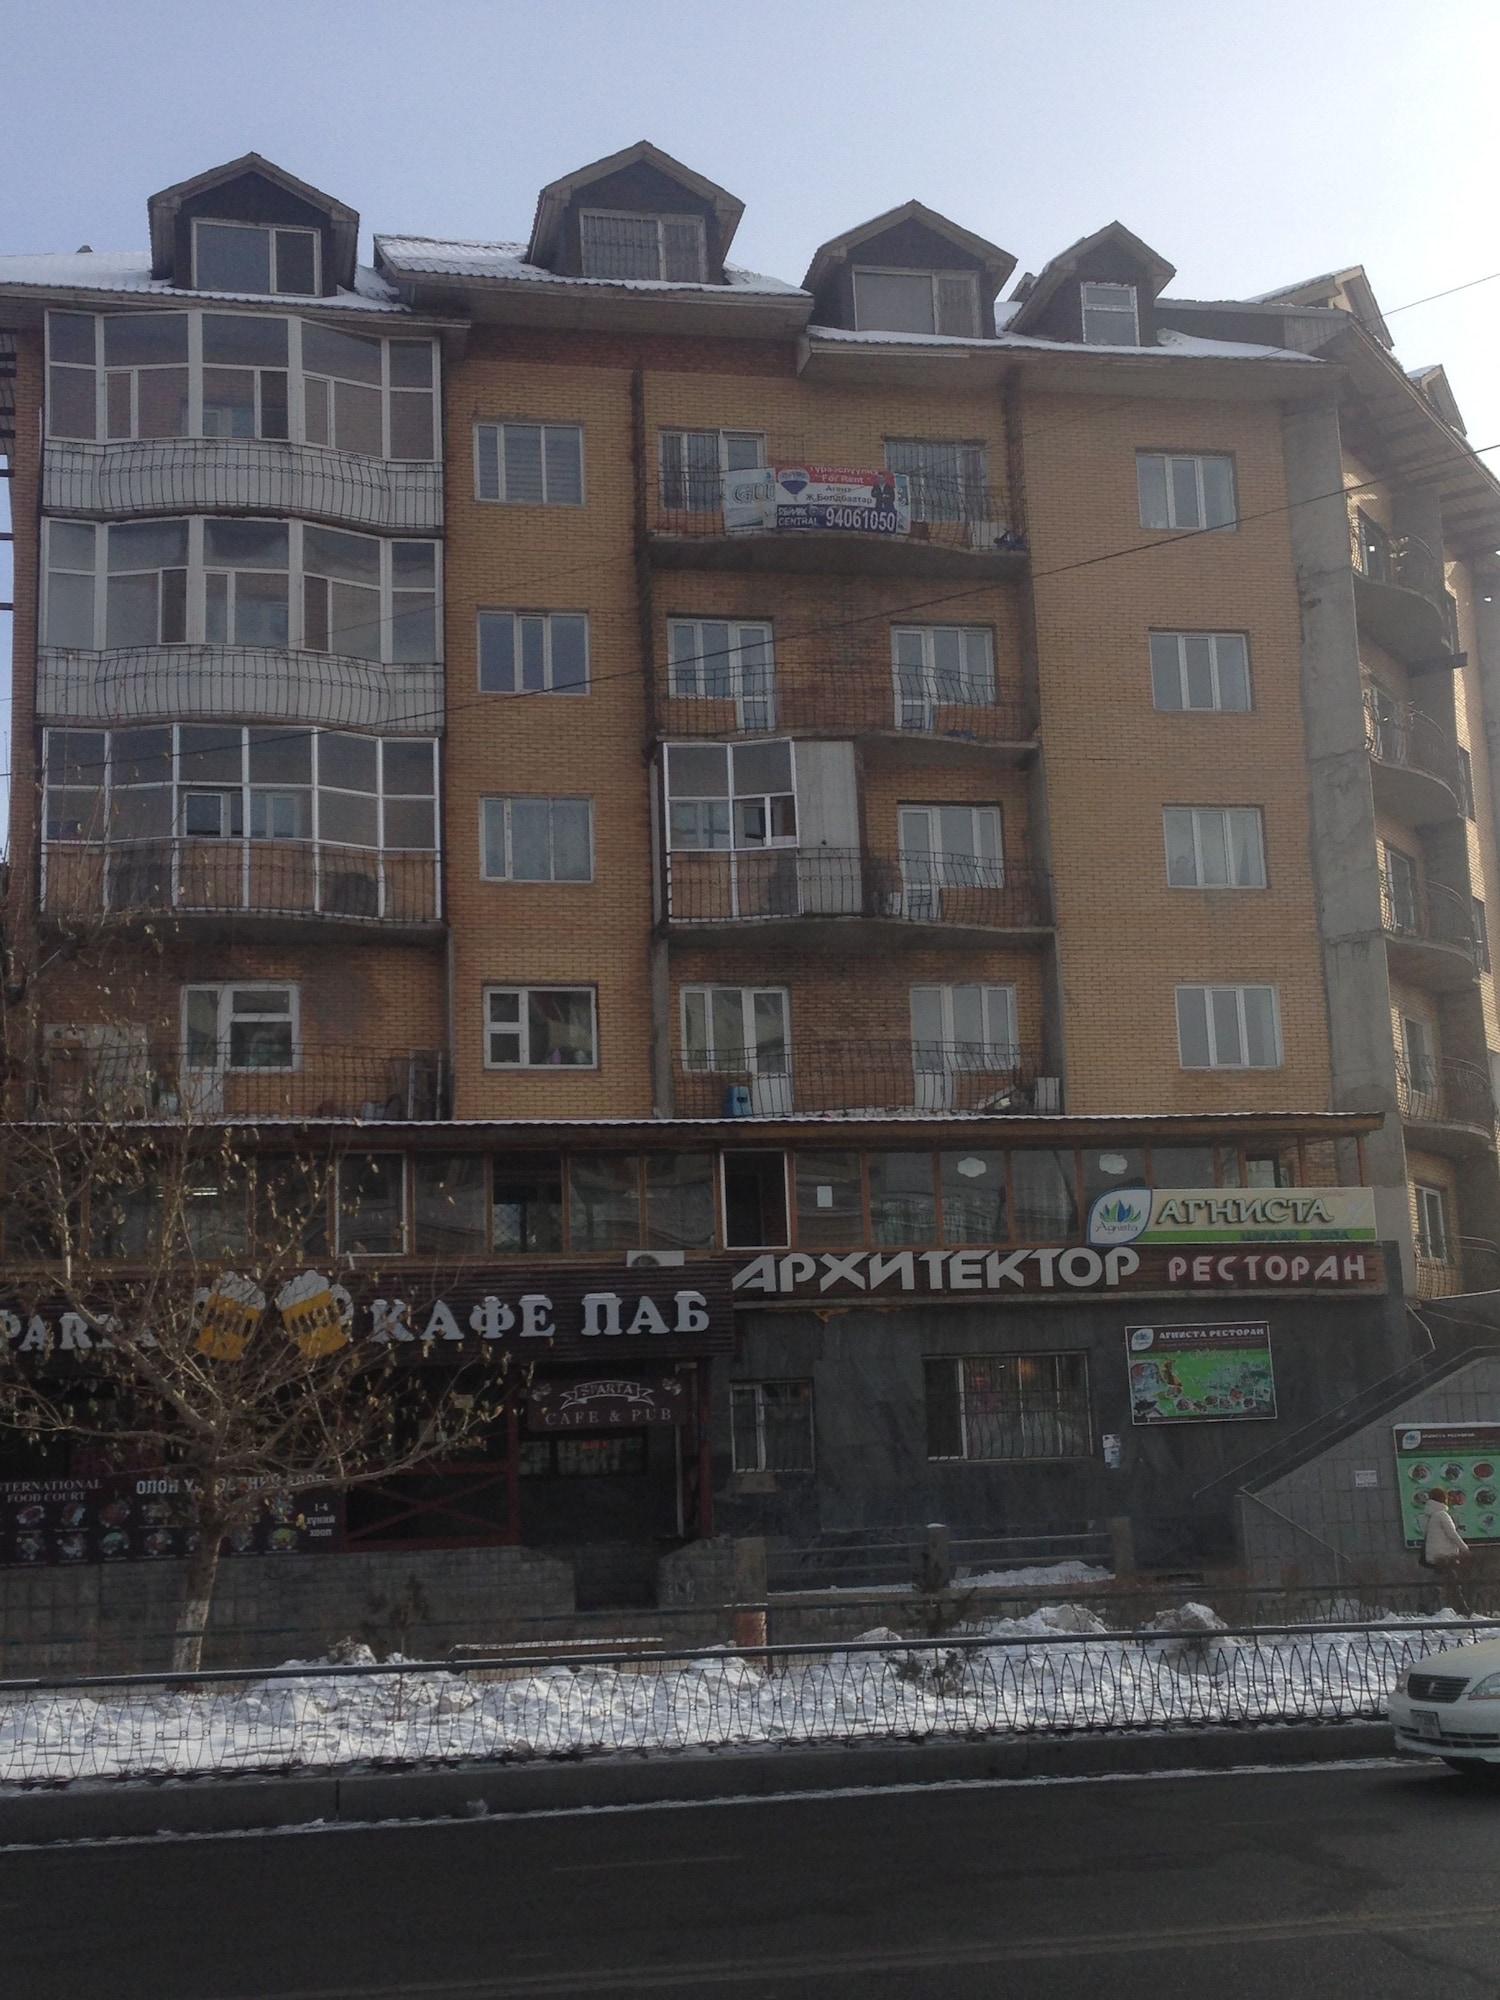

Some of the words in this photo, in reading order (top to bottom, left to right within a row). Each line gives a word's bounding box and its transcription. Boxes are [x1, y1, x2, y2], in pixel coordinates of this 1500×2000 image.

[778, 516, 817, 527] CENTRAL
[825, 507, 896, 532] 94061050
[1155, 1198, 1334, 1225] АГНИСТА
[731, 1247, 1141, 1293] АРХИТЕКТОР
[1167, 1255, 1366, 1283] РЕСТОРАН
[369, 1295, 556, 1343] КАФЕ
[581, 1290, 711, 1337] ПАБ
[1208, 1327, 1266, 1339] РЕСТОРАН
[578, 1382, 634, 1397] SPARTA
[544, 1410, 600, 1426] CAFE
[608, 1409, 622, 1423] &
[631, 1407, 673, 1423] PUB
[135, 1477, 180, 1495] ОЛОН
[7, 1492, 42, 1504] FOOD
[43, 1491, 87, 1503] COURT
